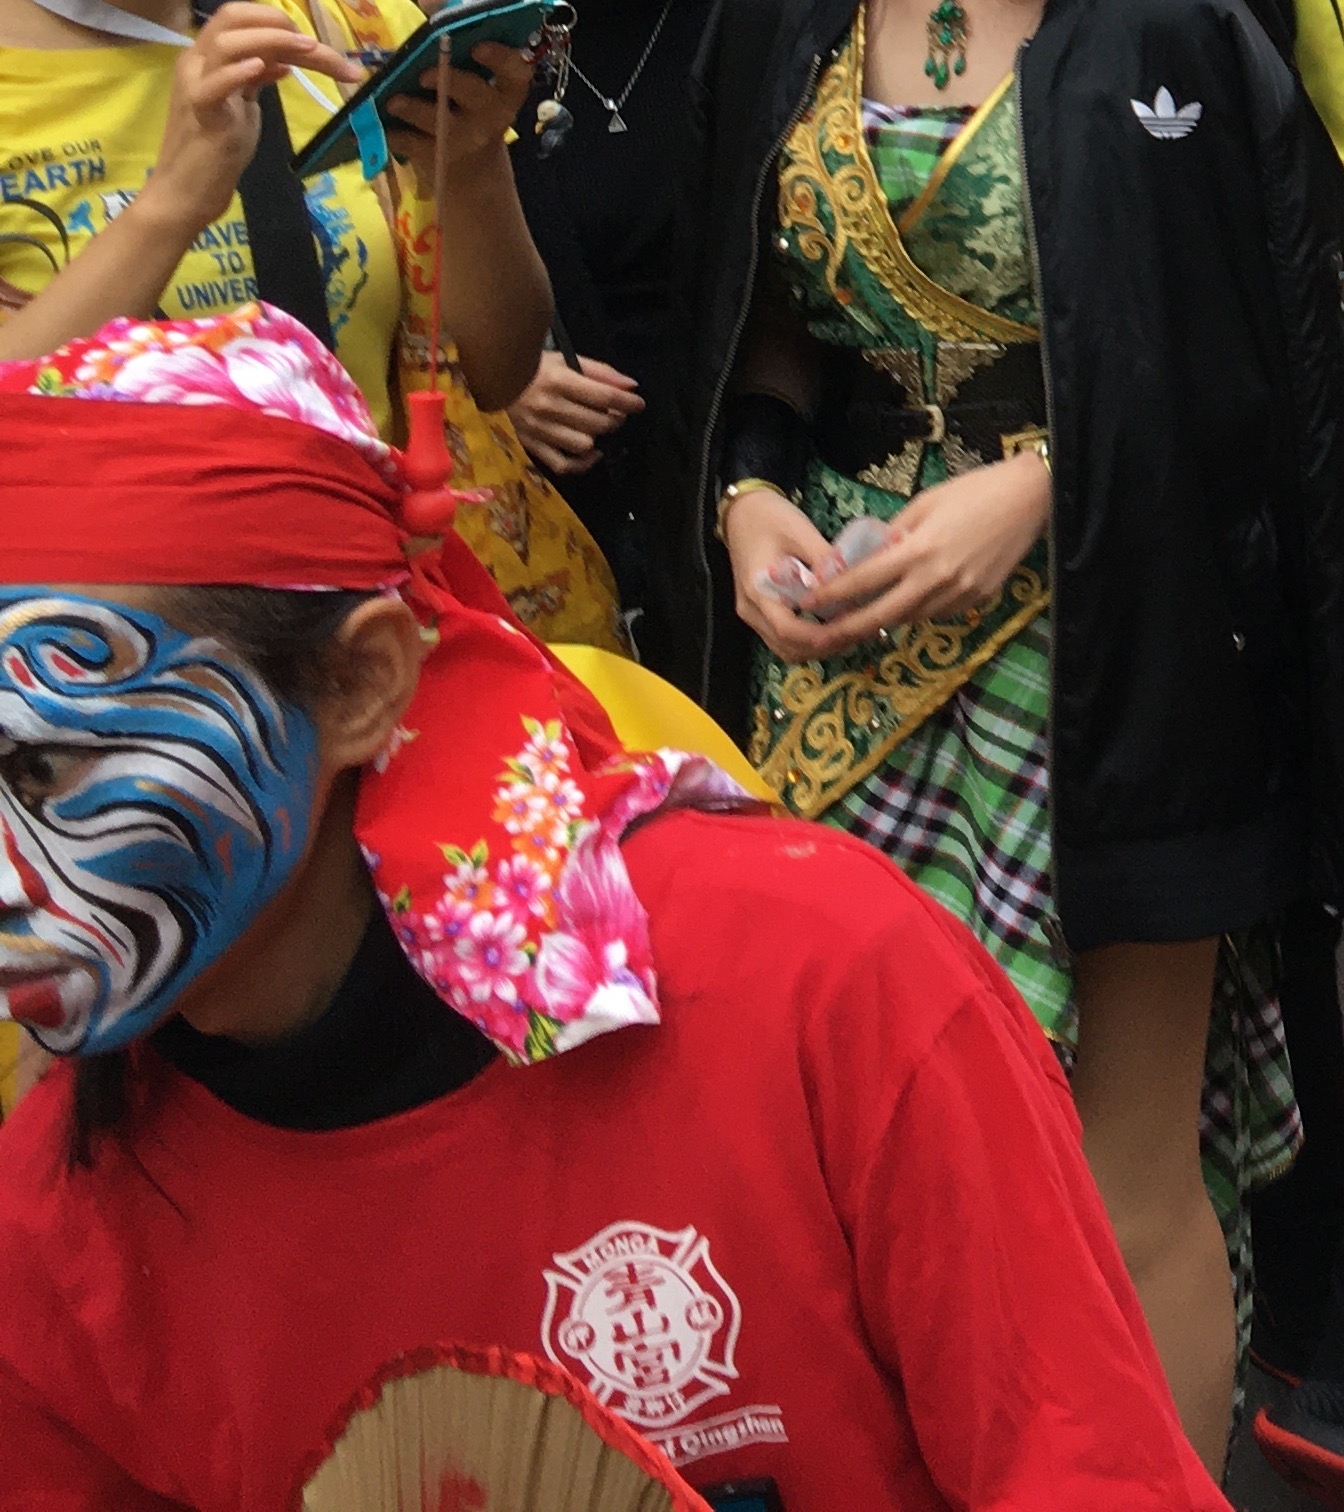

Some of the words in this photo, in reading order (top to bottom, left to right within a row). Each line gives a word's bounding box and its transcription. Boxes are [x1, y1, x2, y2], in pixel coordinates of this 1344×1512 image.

[5, 148, 54, 171] OVE
[0, 156, 106, 203] EARTH
[211, 249, 245, 276] TO
[176, 275, 260, 311] UNIVER
